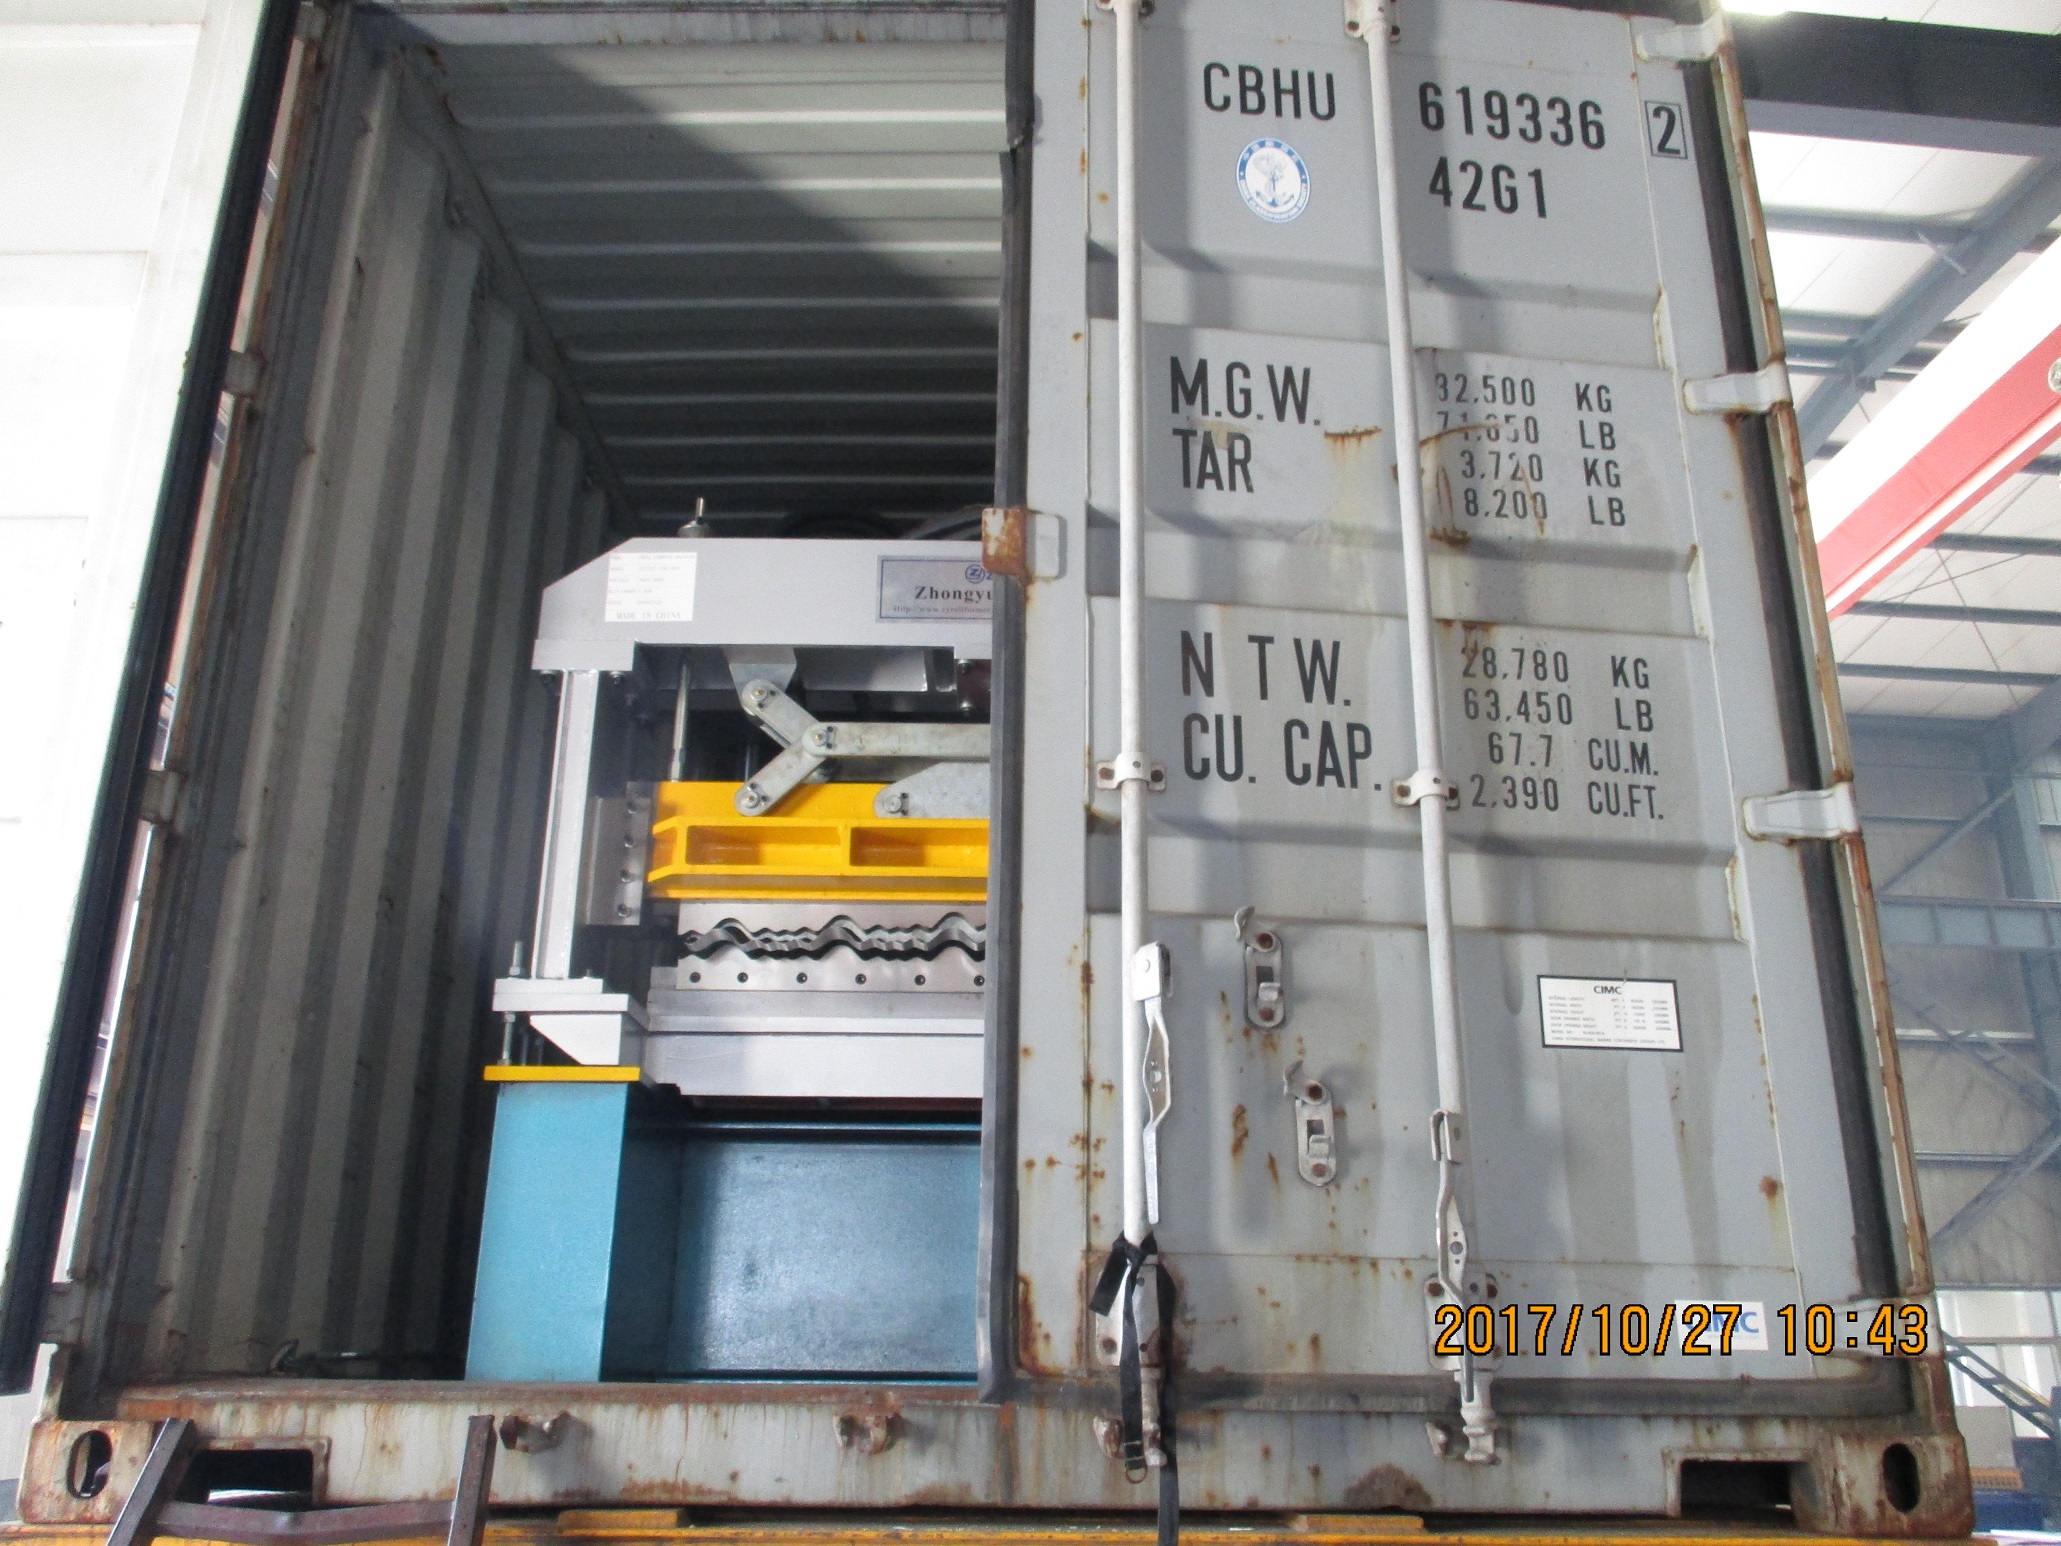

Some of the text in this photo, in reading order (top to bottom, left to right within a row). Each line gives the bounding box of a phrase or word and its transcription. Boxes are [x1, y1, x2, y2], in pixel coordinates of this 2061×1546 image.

[1203, 62, 1682, 155] CBHU 619336 2
[1428, 156, 1548, 219] 42G1
[1170, 355, 1321, 426] M.G.W.
[1575, 382, 1613, 413] KG
[1172, 428, 1255, 494] TAR
[1583, 457, 1622, 488] KG
[1579, 420, 1617, 451] LB
[1588, 495, 1627, 527] LB
[1181, 630, 1215, 698] N
[1611, 655, 1651, 690] KG
[1615, 697, 1655, 733] LB
[1183, 712, 1257, 784] CU.
[1284, 718, 1382, 792] CAP.
[1488, 731, 1554, 768] 67.7
[1593, 985, 1622, 995] CIMC
